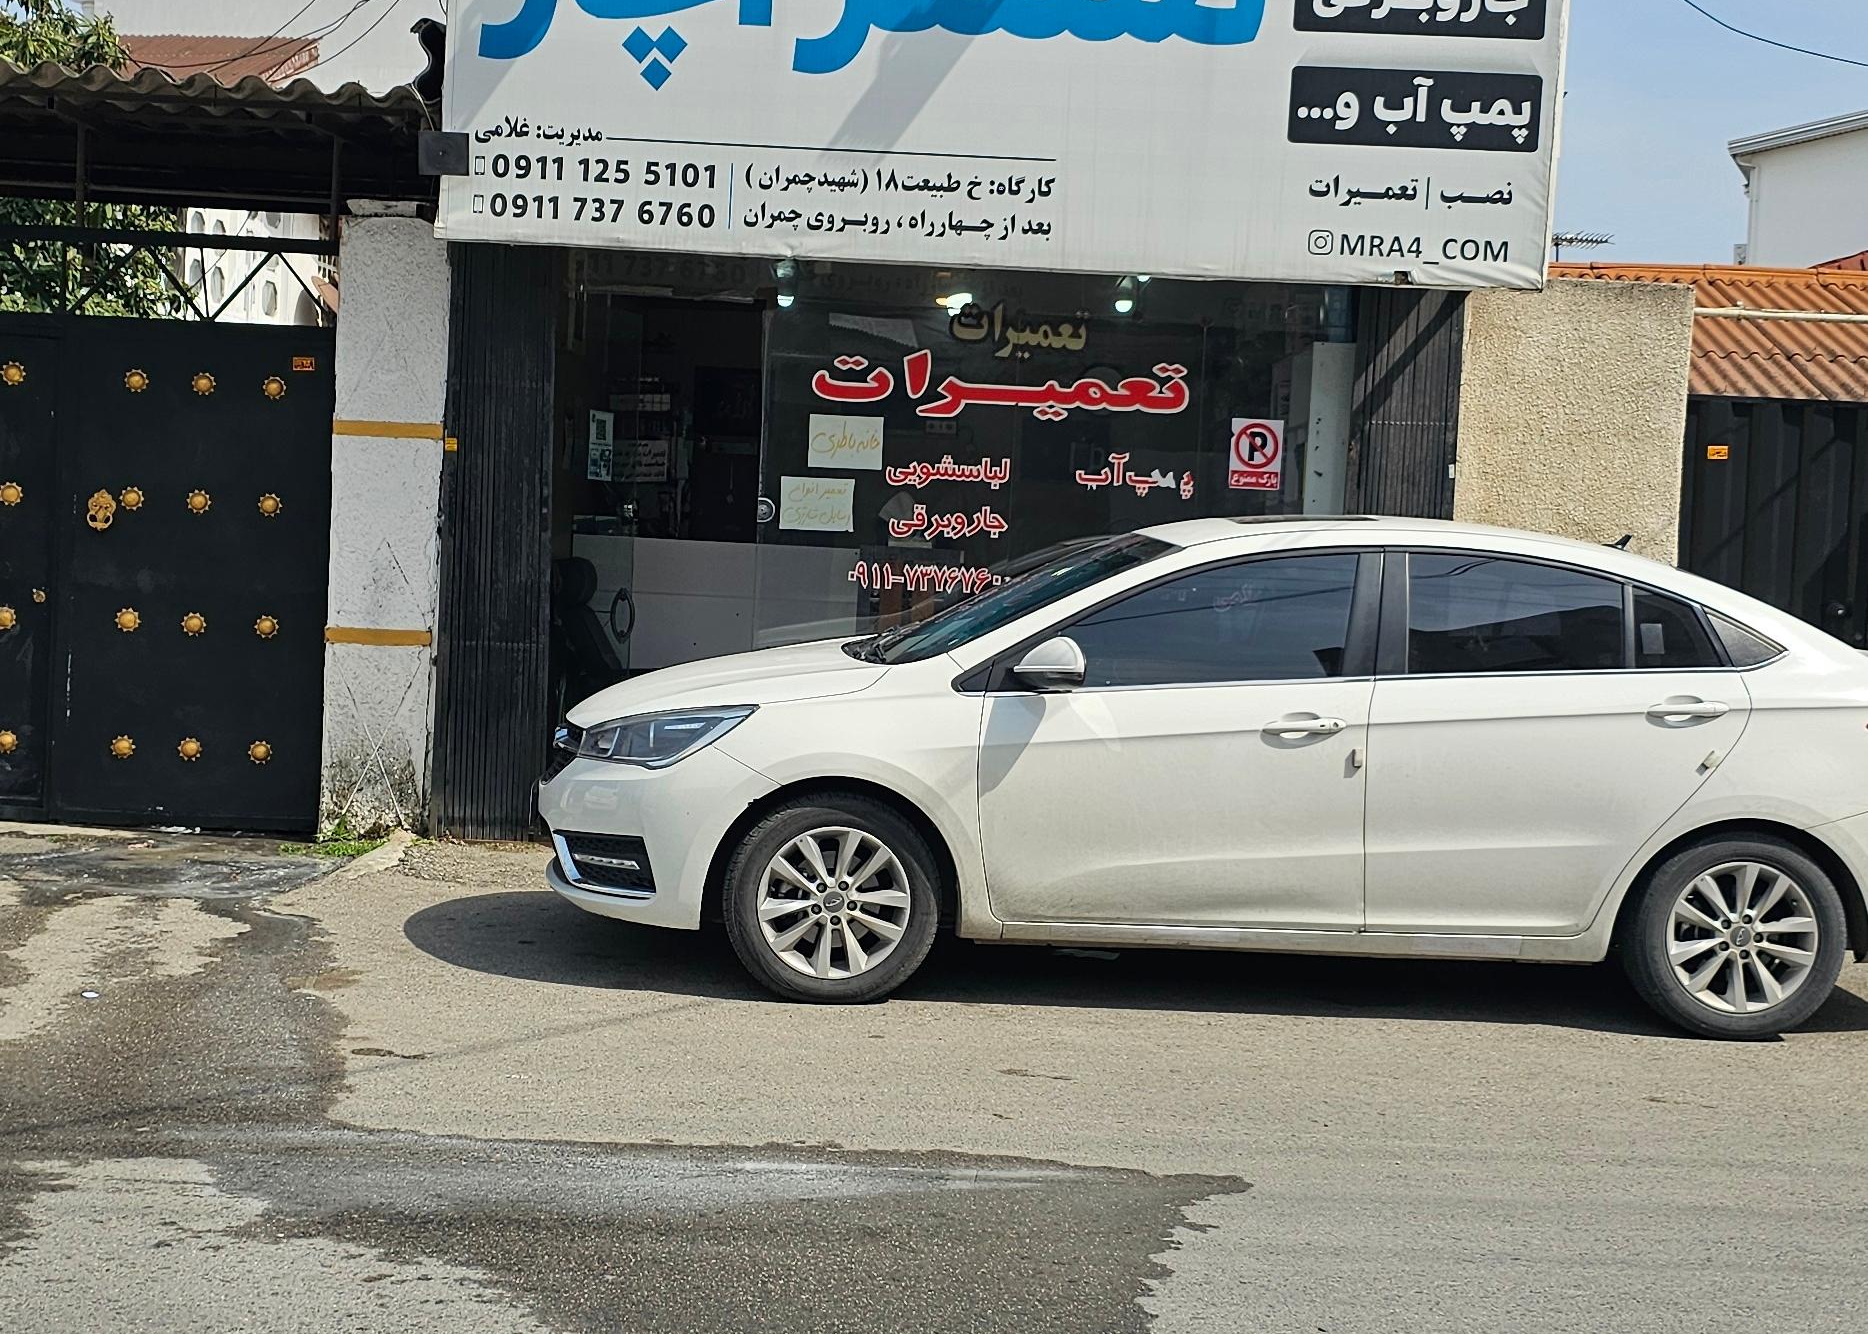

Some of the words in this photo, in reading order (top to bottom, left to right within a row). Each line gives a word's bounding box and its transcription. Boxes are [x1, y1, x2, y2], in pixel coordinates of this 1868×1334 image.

[1373, 76, 1434, 135] آب
[1440, 97, 1531, 145] پمپ
[474, 115, 530, 144] غلامی
[492, 153, 564, 181] 0911
[578, 157, 631, 184] 125
[644, 161, 716, 189] 5101
[489, 192, 560, 220] 0911
[573, 196, 625, 223] 737
[637, 200, 716, 229] 6760
[1439, 181, 1513, 210] نصب
[743, 201, 803, 232] چمران
[997, 214, 1016, 241] از
[1021, 219, 1052, 241] بعد
[1339, 233, 1509, 266] MRA4_COM
[812, 349, 1189, 421] تعمیرات
[886, 455, 1011, 490] لباسشویی
[889, 504, 1009, 541] جاروبرقی
